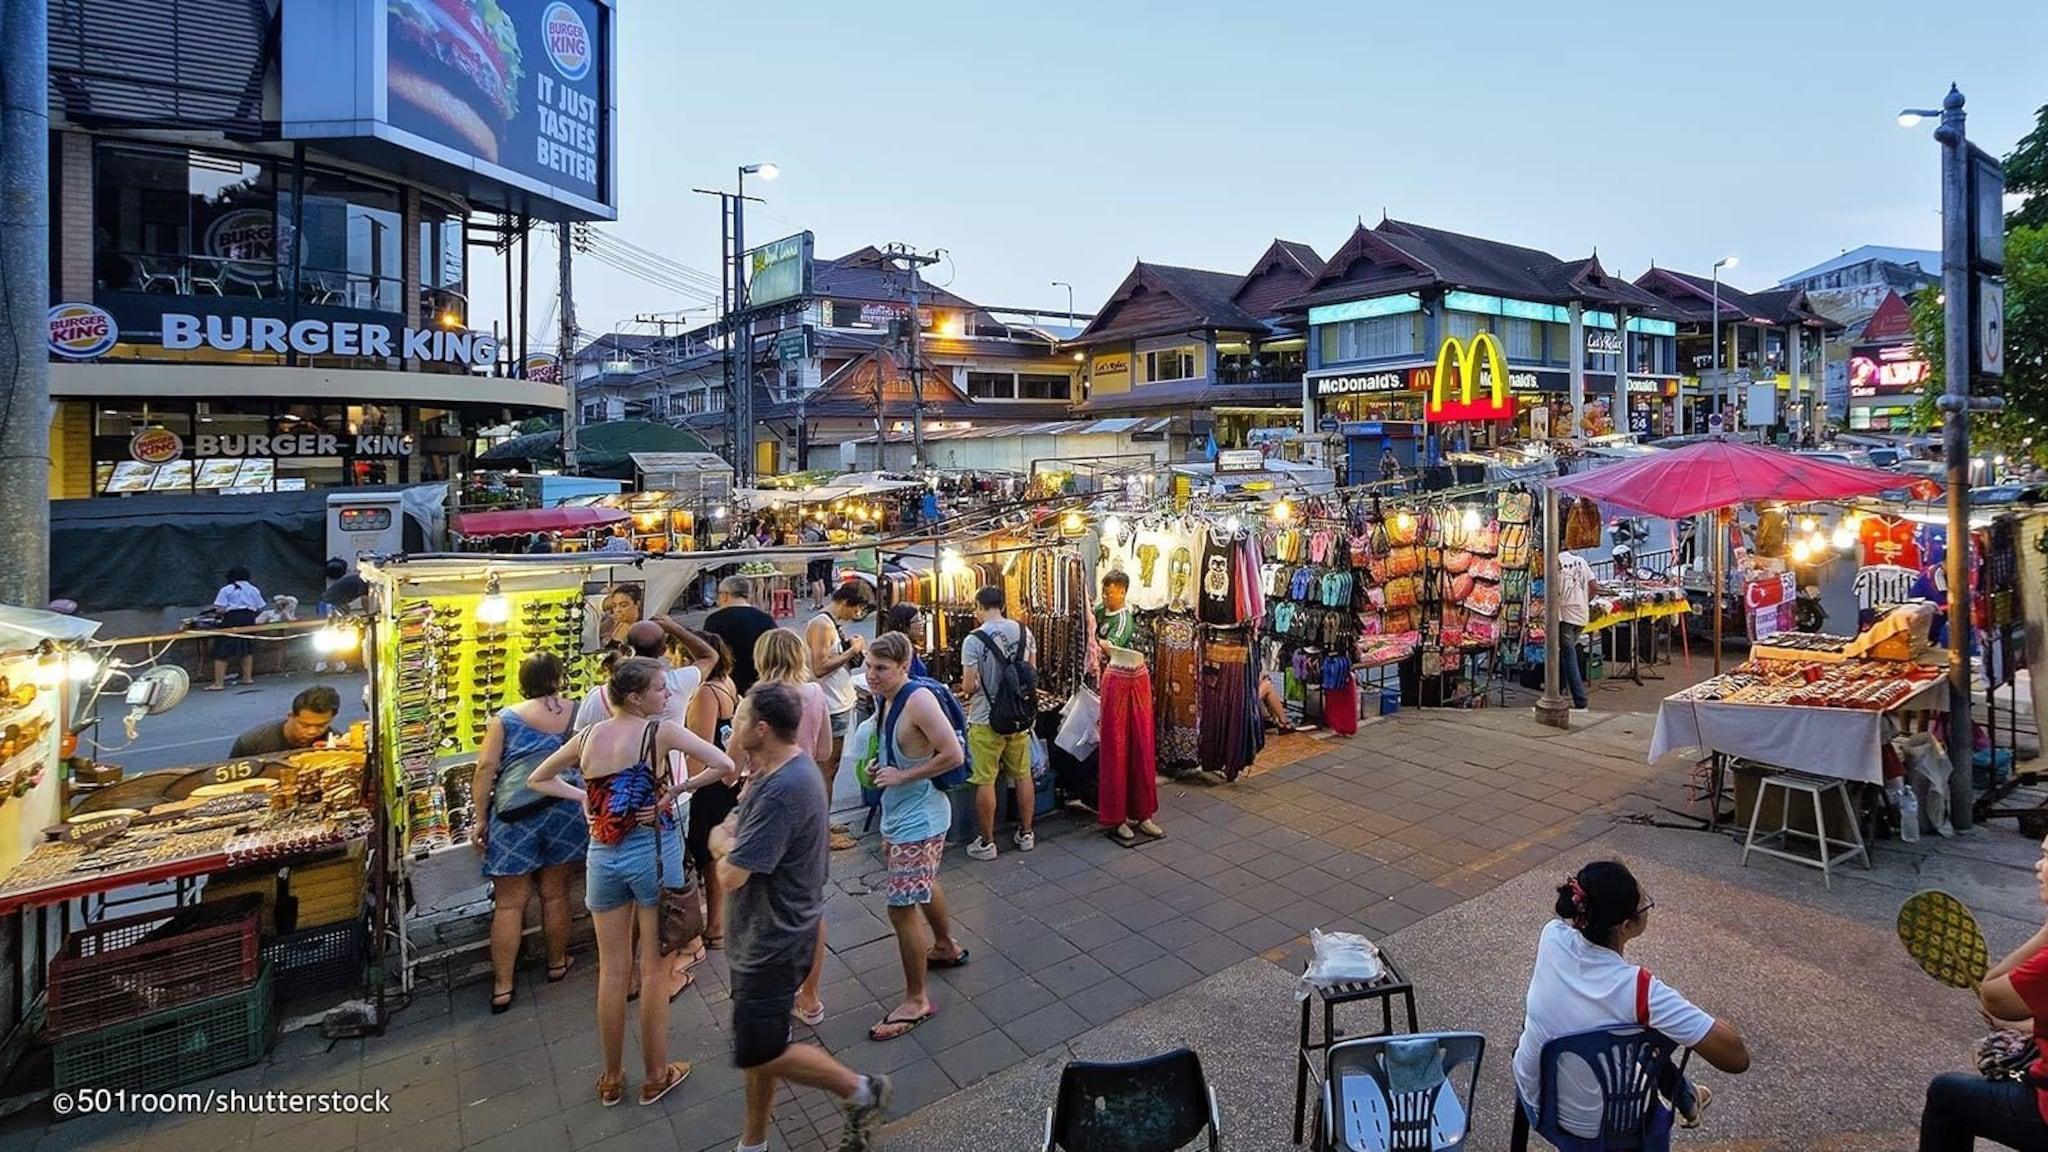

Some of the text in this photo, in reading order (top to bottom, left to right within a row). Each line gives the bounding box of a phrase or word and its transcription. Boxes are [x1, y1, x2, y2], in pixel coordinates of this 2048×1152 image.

[549, 21, 584, 39] BURGER
[551, 35, 585, 56] KING
[538, 72, 597, 125] IT JUST
[537, 104, 597, 154] TASTES
[537, 135, 597, 185] BETTER
[50, 314, 108, 331] BURGER
[52, 325, 109, 343] KING
[162, 313, 498, 365] BURGER KING
[1632, 417, 1648, 430] 24
[141, 441, 176, 456] KING
[196, 434, 415, 456] BURGER KING
[215, 760, 252, 783] 515
